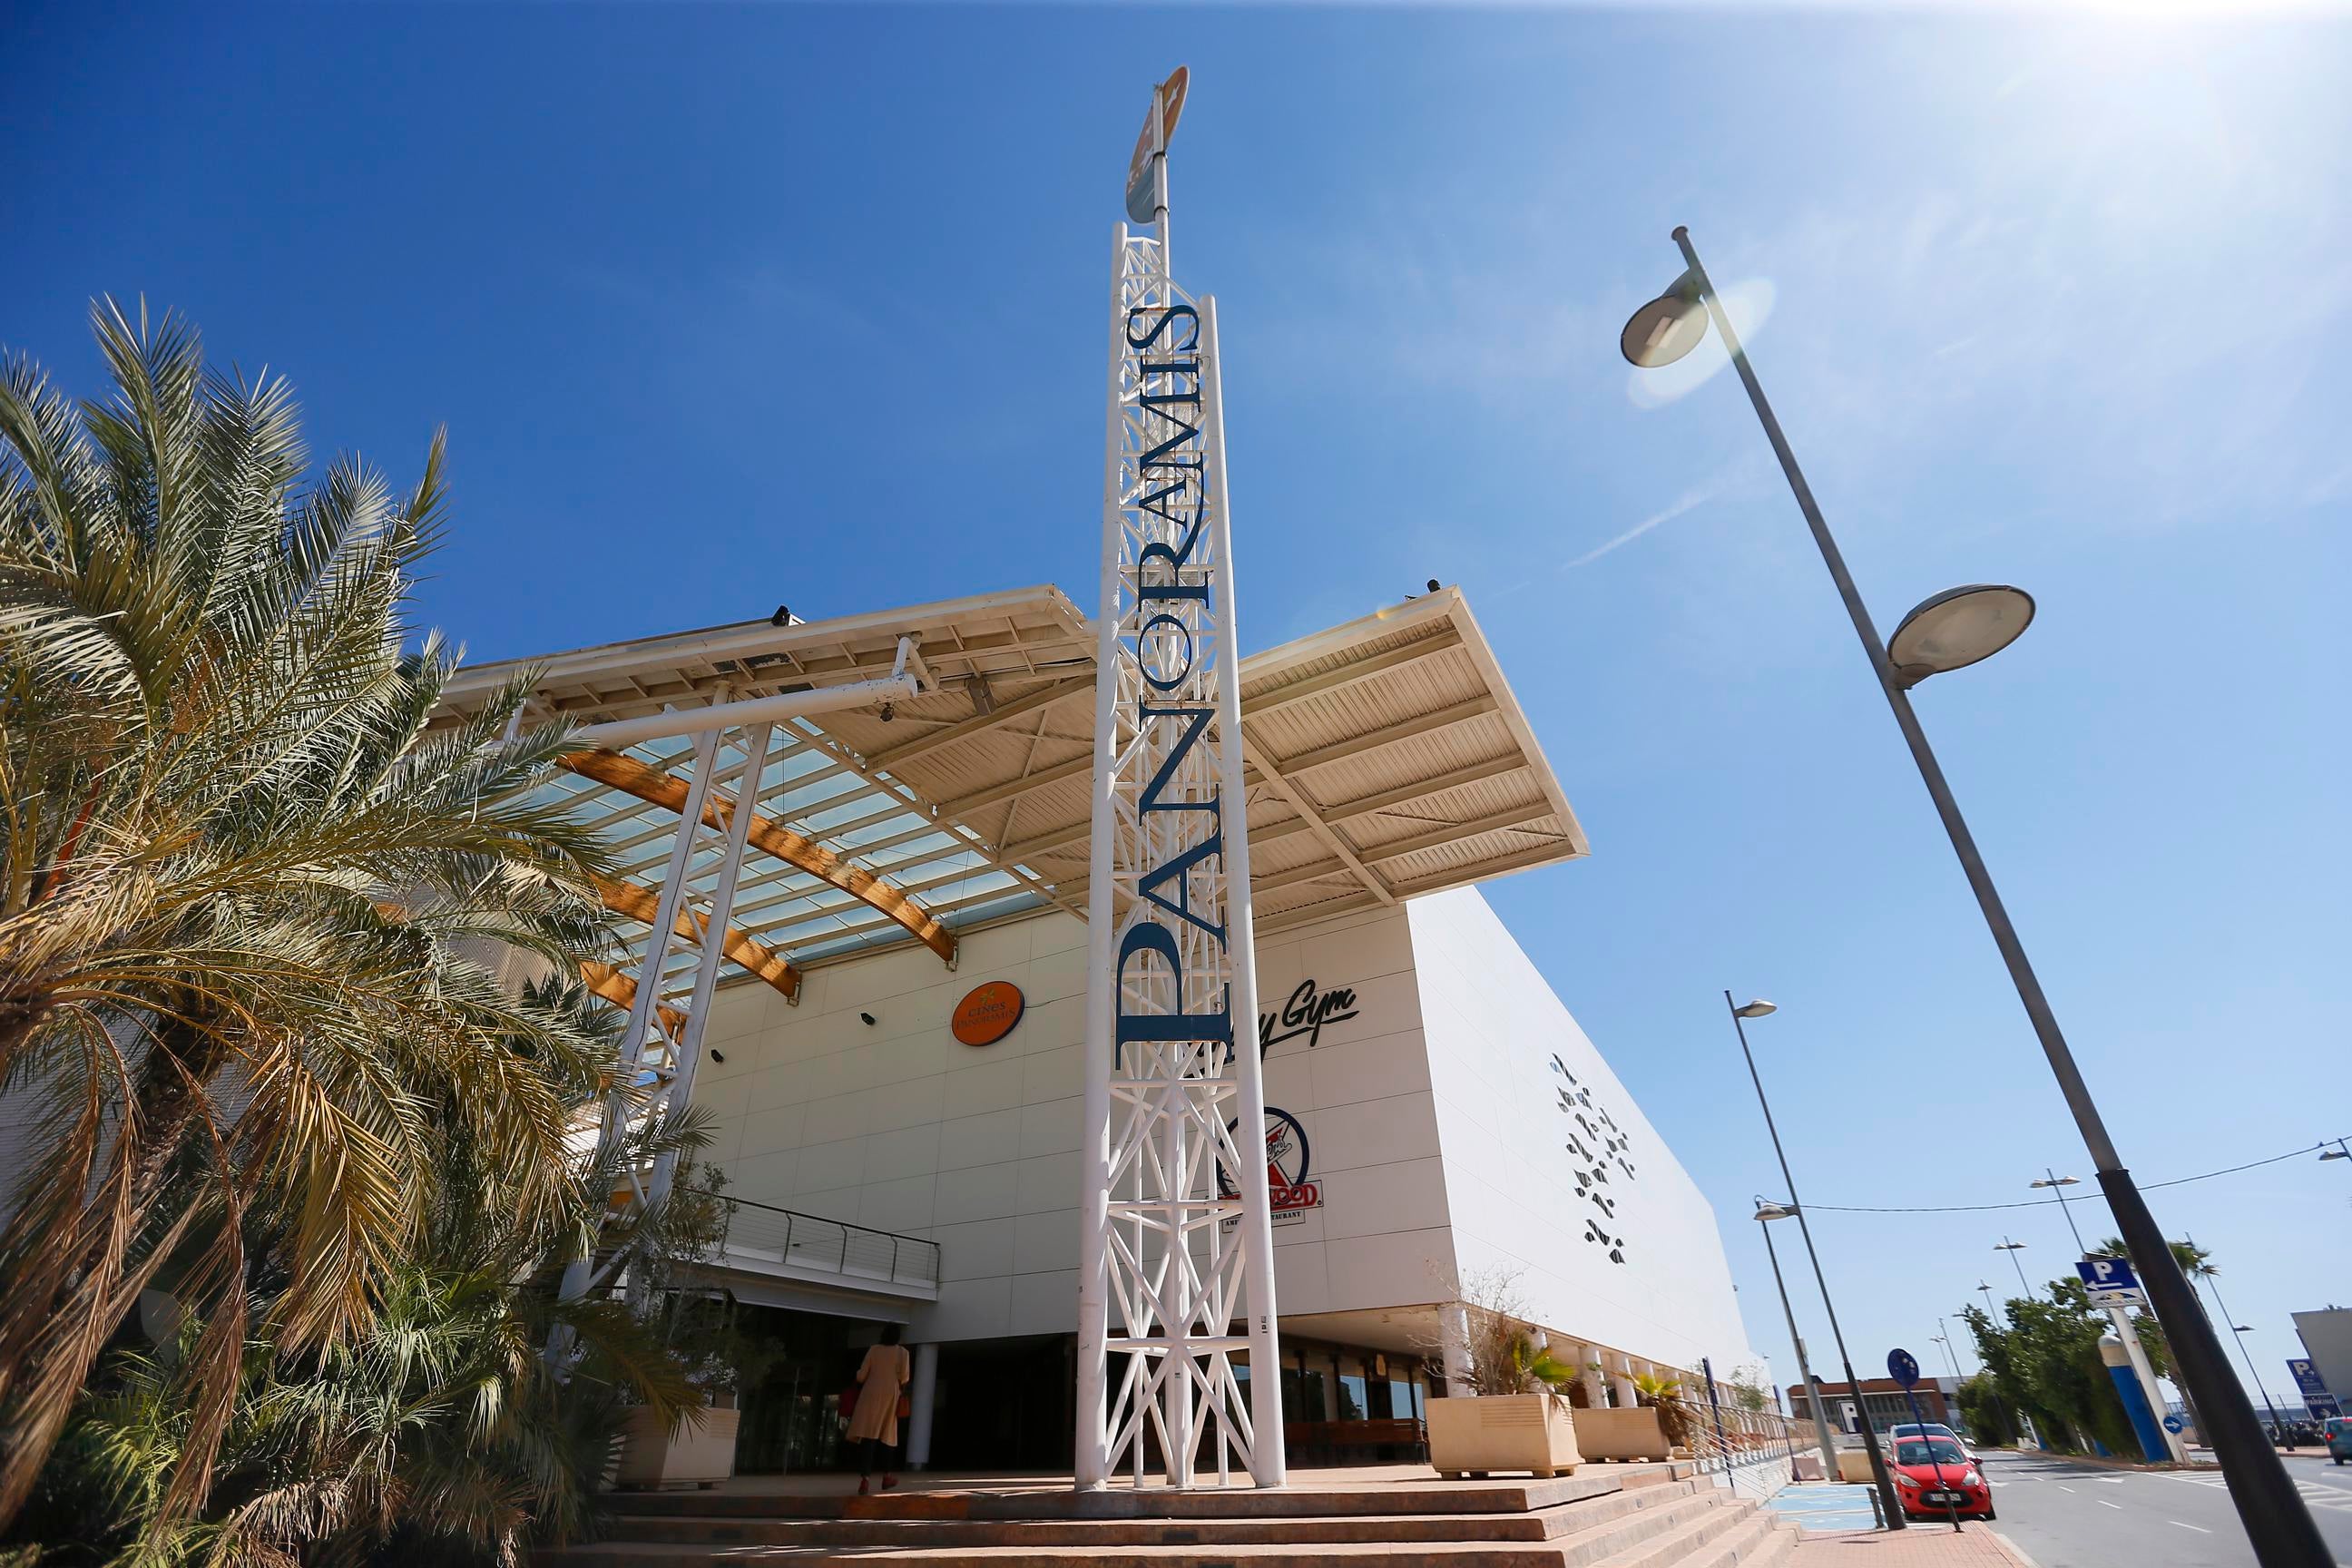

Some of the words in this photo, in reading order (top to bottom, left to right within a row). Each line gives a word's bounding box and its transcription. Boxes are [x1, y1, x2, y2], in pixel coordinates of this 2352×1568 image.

[1116, 304, 1232, 1071] PANORAMIS
[1282, 978, 1357, 1047] Gym
[2092, 1261, 2112, 1280] P
[2293, 1362, 2309, 1376] P
